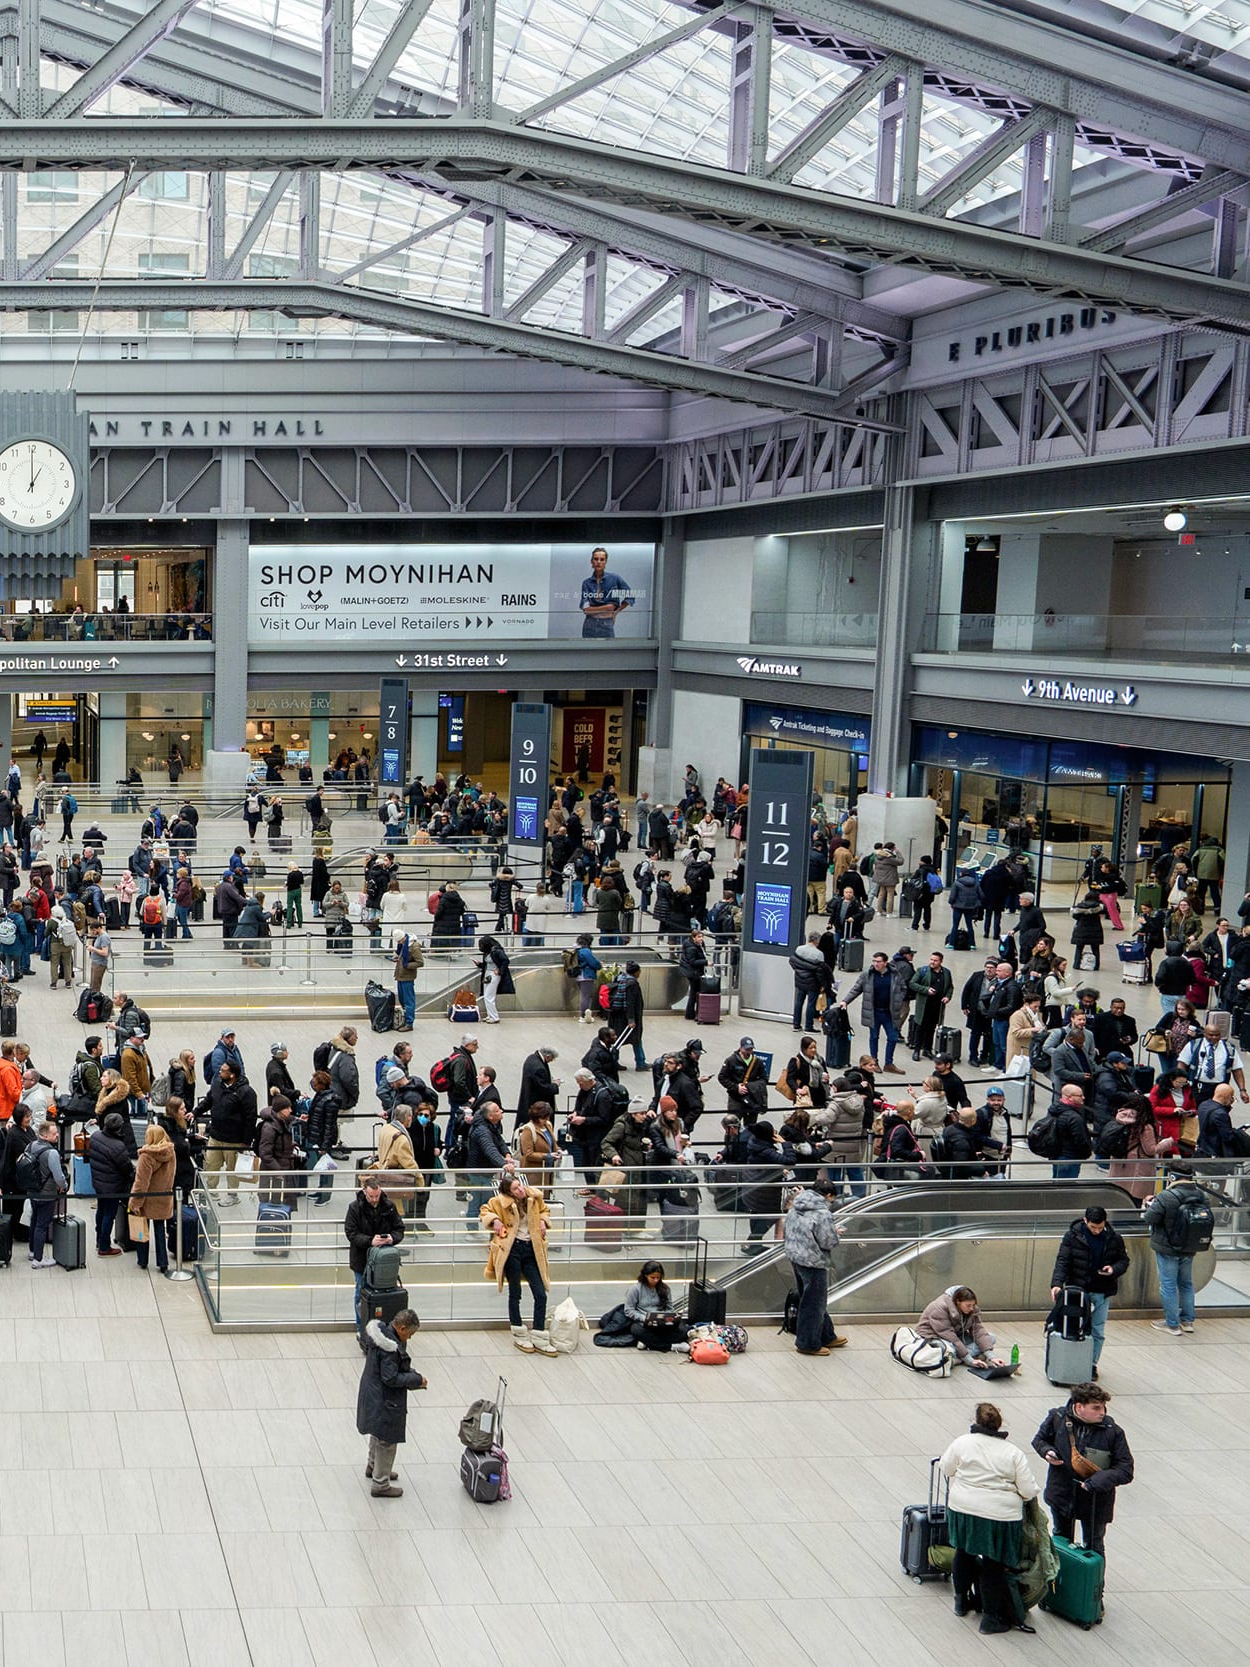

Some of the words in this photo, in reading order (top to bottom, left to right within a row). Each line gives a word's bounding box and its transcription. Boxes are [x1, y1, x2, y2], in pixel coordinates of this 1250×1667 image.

[948, 342, 960, 362] E
[141, 420, 231, 436] TRAIN
[253, 420, 325, 436] HALL
[11, 449, 19, 457] 11
[59, 462, 65, 471] 2
[63, 480, 70, 488] 3
[0, 497, 5, 506] 8
[58, 497, 64, 506] 4
[11, 511, 18, 519] 7
[29, 515, 35, 524] 6
[46, 510, 52, 519] 5
[260, 565, 333, 584] SHOP
[346, 564, 493, 584] MOYNIHAN
[260, 591, 286, 608] citi
[340, 597, 409, 605] (MALIN+GOETZ)
[427, 596, 487, 604] MOLESKINE
[501, 594, 536, 606] RAINS
[300, 602, 329, 611] lovepop
[260, 617, 290, 630] Visit
[294, 617, 320, 630] Our
[325, 617, 357, 630] Main
[362, 616, 396, 630] Level
[401, 616, 460, 630] Retailers
[50, 657, 101, 672] Lounge
[414, 654, 443, 667] 31st
[446, 653, 489, 667] Street
[752, 663, 799, 676] AMTRAK
[1038, 680, 1060, 699] 9th
[1063, 682, 1114, 704] Avenue
[280, 698, 332, 709] BAKERY
[388, 705, 396, 718] 7
[387, 726, 396, 739] 8
[574, 723, 594, 733] COLD
[782, 719, 798, 729] Amtrak
[844, 728, 865, 740] Check-in
[522, 739, 534, 756] 9
[518, 767, 537, 784] 10
[766, 801, 789, 826] 11
[761, 841, 790, 866] 12
